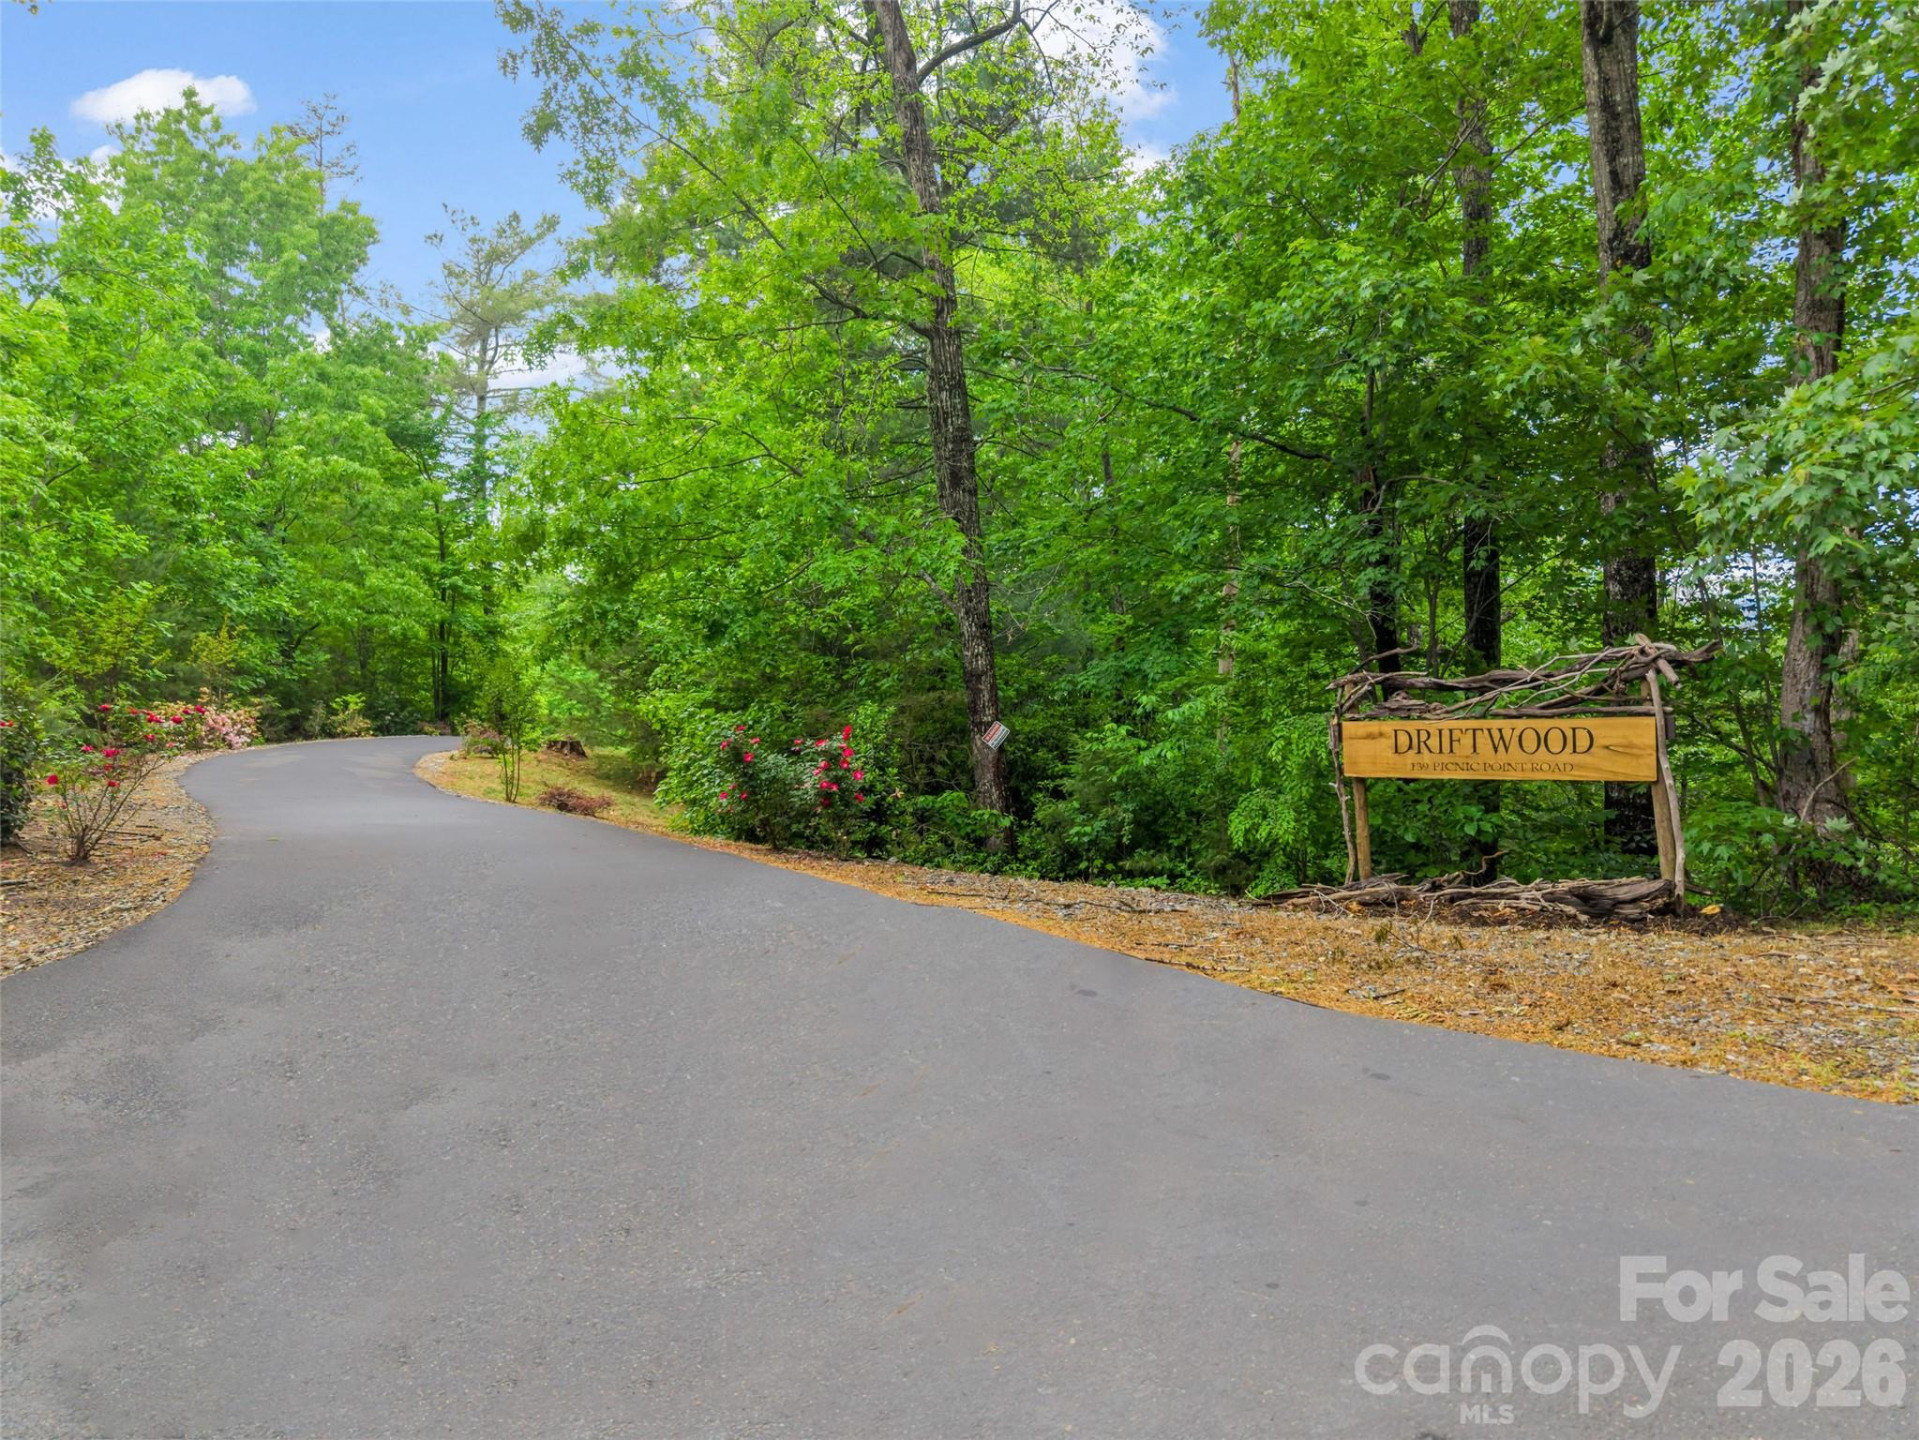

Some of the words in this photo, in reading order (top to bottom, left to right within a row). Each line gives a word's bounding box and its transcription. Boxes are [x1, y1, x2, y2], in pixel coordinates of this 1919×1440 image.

[1392, 726, 1594, 756] DRIFTWOOD
[1432, 761, 1481, 773] PICNIC
[1483, 761, 1527, 773] POINT
[1531, 761, 1574, 773] ROAD
